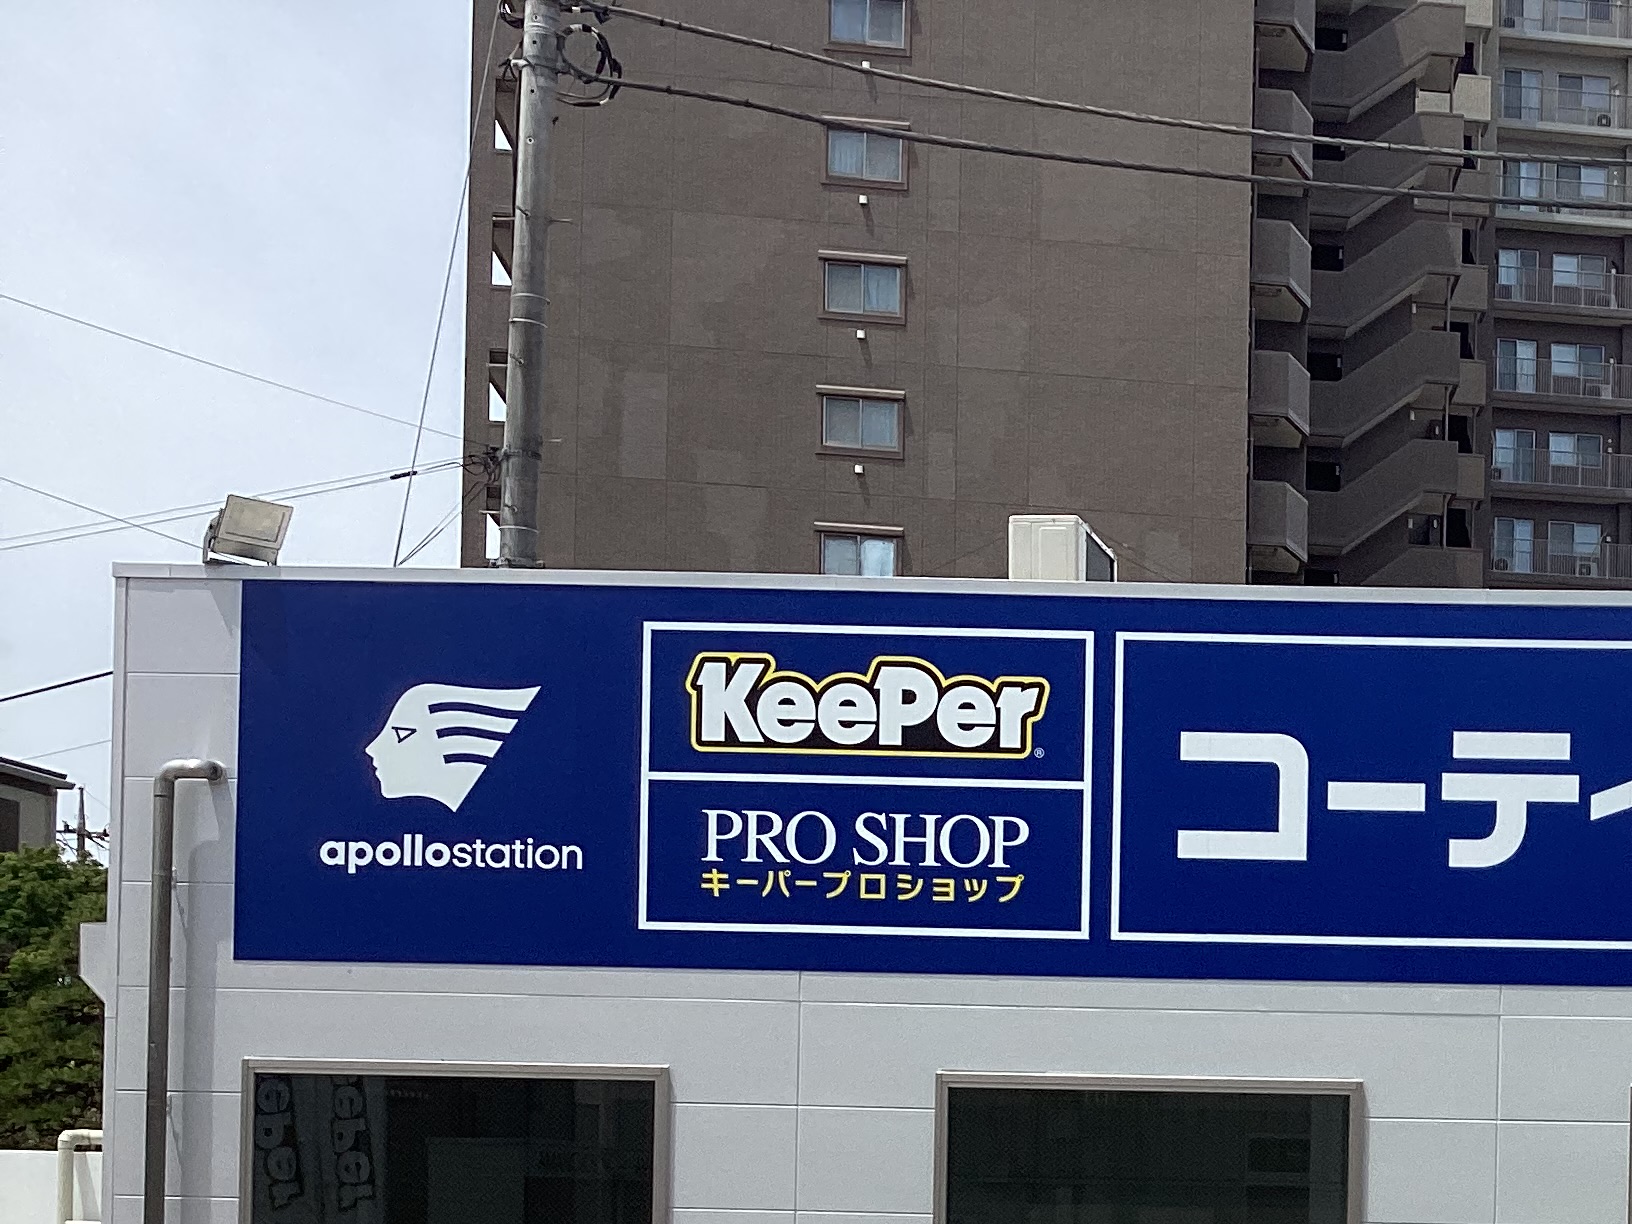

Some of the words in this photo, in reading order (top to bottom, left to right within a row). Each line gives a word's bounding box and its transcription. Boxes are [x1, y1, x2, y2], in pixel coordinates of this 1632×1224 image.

[696, 661, 1040, 750] KeePer
[319, 833, 584, 875] apollostation
[700, 808, 837, 866] PRO
[852, 811, 1031, 869] SHOP
[700, 868, 1026, 903] キーパープロショップ
